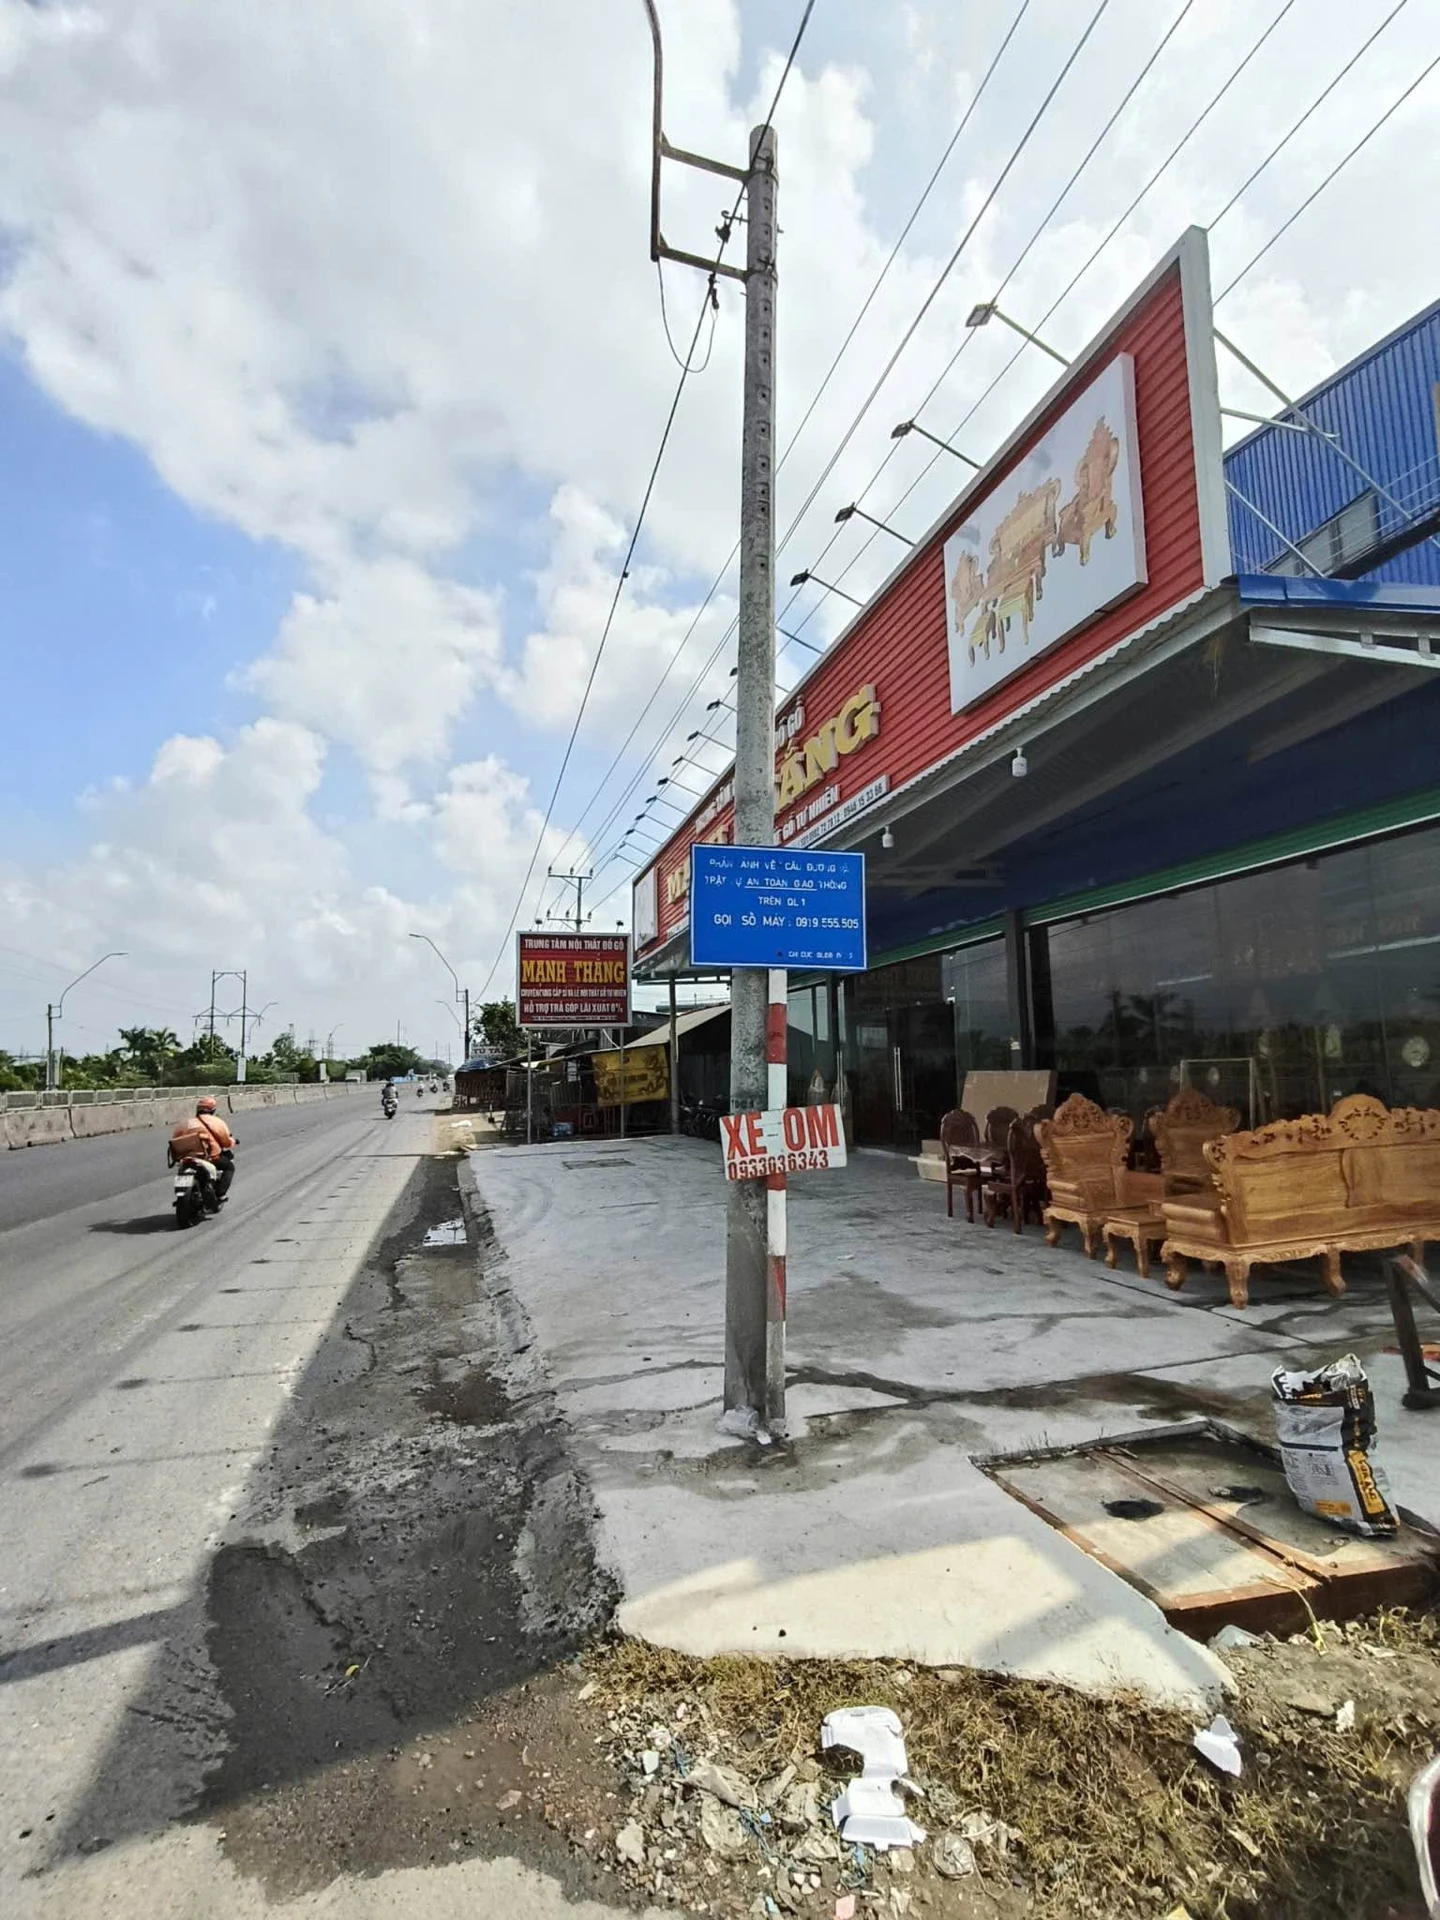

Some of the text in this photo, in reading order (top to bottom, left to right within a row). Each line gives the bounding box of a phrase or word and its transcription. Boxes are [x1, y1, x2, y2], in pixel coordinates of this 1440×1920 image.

[525, 939, 550, 949] TRUNG
[574, 952, 625, 983] THẮNG
[721, 1110, 768, 1161] XE
[728, 1149, 829, 1181] 0933036343
